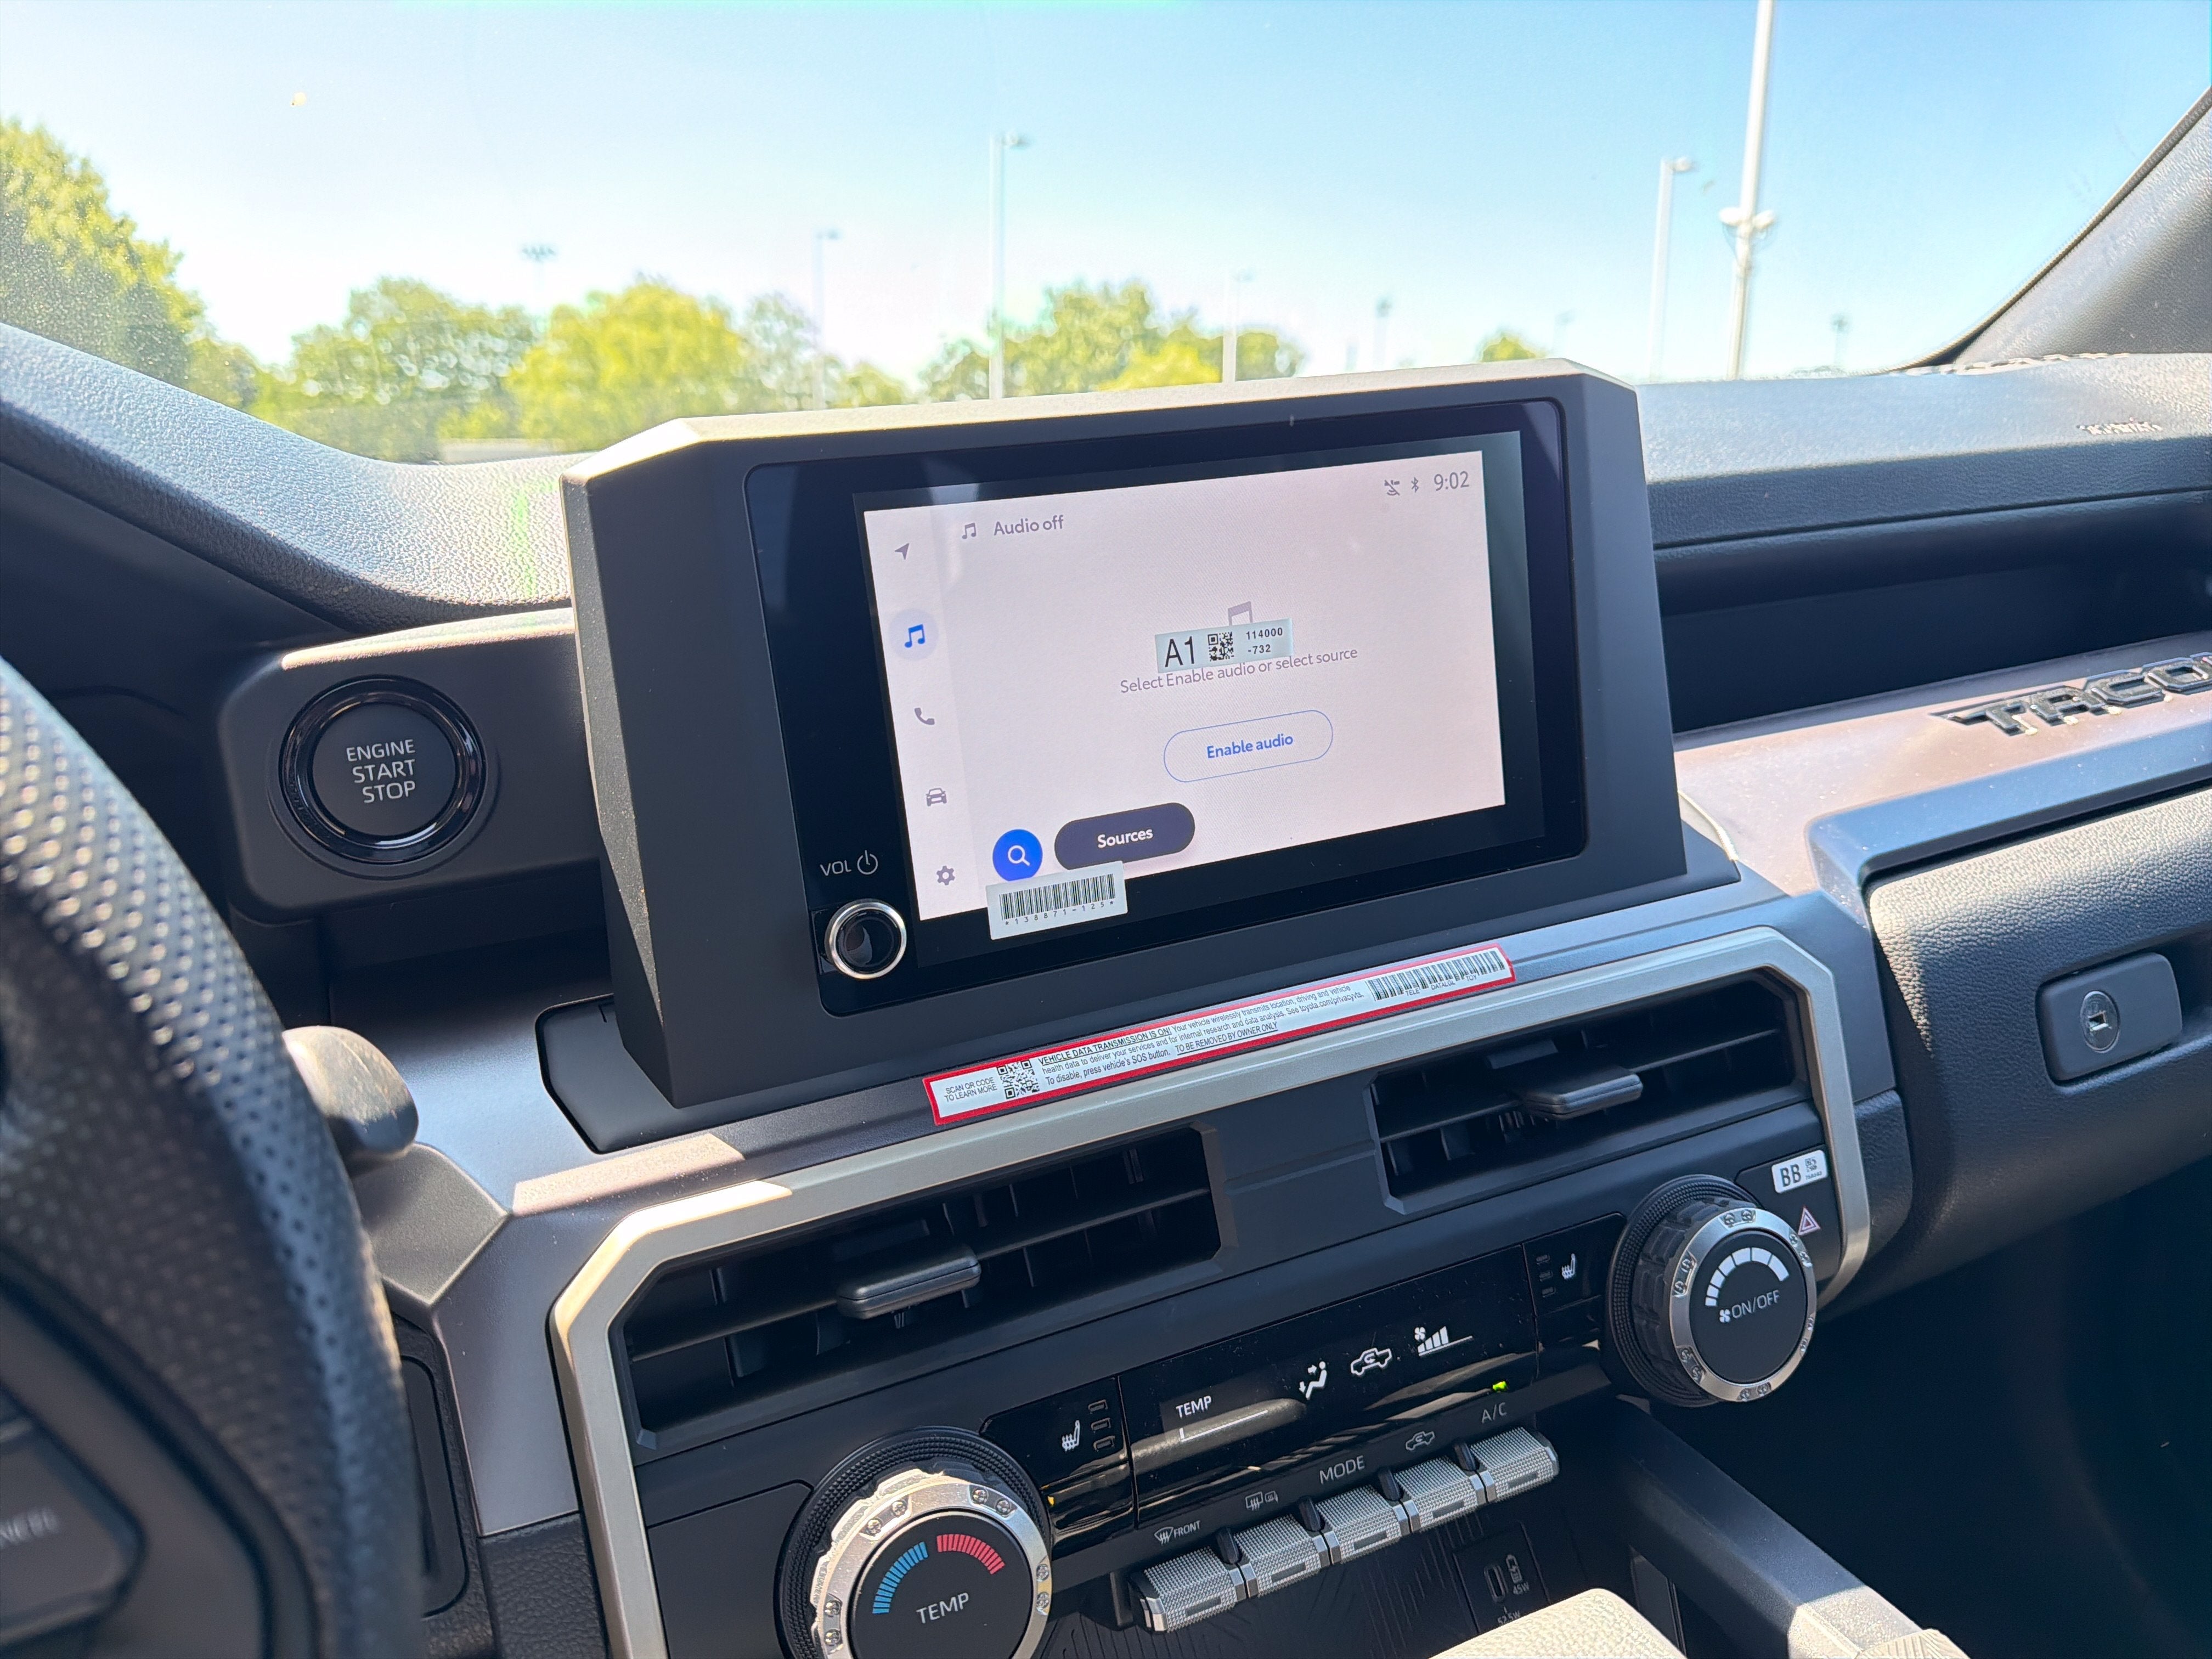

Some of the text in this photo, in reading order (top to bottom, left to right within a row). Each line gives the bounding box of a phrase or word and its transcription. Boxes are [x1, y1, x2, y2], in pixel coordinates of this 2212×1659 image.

[1434, 471, 1470, 491] 9:02
[994, 514, 1064, 536] Audio off
[1245, 627, 1284, 641] 114000
[1164, 635, 1195, 668] A1
[1248, 644, 1272, 655] -732
[1120, 648, 1358, 693] Select Enable audio or select source
[346, 739, 416, 763] ENGINE
[1207, 733, 1294, 759] Enable audio
[352, 759, 416, 783] START
[362, 781, 416, 804] STOP
[1097, 827, 1153, 849] Sources
[820, 859, 852, 877] VOL
[1406, 988, 1420, 996] TELE
[1038, 985, 1351, 1065] VEHICLE DATA TRANSMISSION IS ON! Your vehicle wirelessly transmits location, driving and vehicle
[1042, 1064, 1064, 1075] health
[1065, 1060, 1080, 1069] data
[1090, 1053, 1111, 1063] deliver
[1112, 1048, 1127, 1059] your
[1128, 1042, 1155, 1054] services
[1156, 1037, 1169, 1047] and
[1204, 1023, 1232, 1035] research
[1232, 1019, 1244, 1029] and
[1245, 1017, 1259, 1025] data
[1260, 1011, 1286, 1022] analysis.
[1046, 1076, 1055, 1086] To
[1057, 1070, 1082, 1083] disable,
[1084, 1066, 1102, 1079] press
[1132, 1053, 1147, 1064] SOS
[1148, 1049, 1171, 1060] button.
[1175, 1044, 1185, 1053] TO
[1186, 1041, 1195, 1051] BE
[1195, 1034, 1227, 1048] REMOVED
[1227, 1031, 1235, 1040] BY
[1237, 1025, 1261, 1037] OWNER
[1262, 1021, 1277, 1032] ONLY
[944, 1084, 998, 1102] TO LEARN MORE
[946, 1076, 995, 1094] SCAN QR CODE
[1780, 1163, 1802, 1187] BB
[1731, 1289, 1781, 1319] ON/OFF
[1175, 1395, 1212, 1419] TEMP
[1481, 1402, 1507, 1423] A/C
[1319, 1455, 1365, 1484] MODE
[1173, 1520, 1201, 1538] FRONT
[916, 1592, 969, 1624] TEMP
